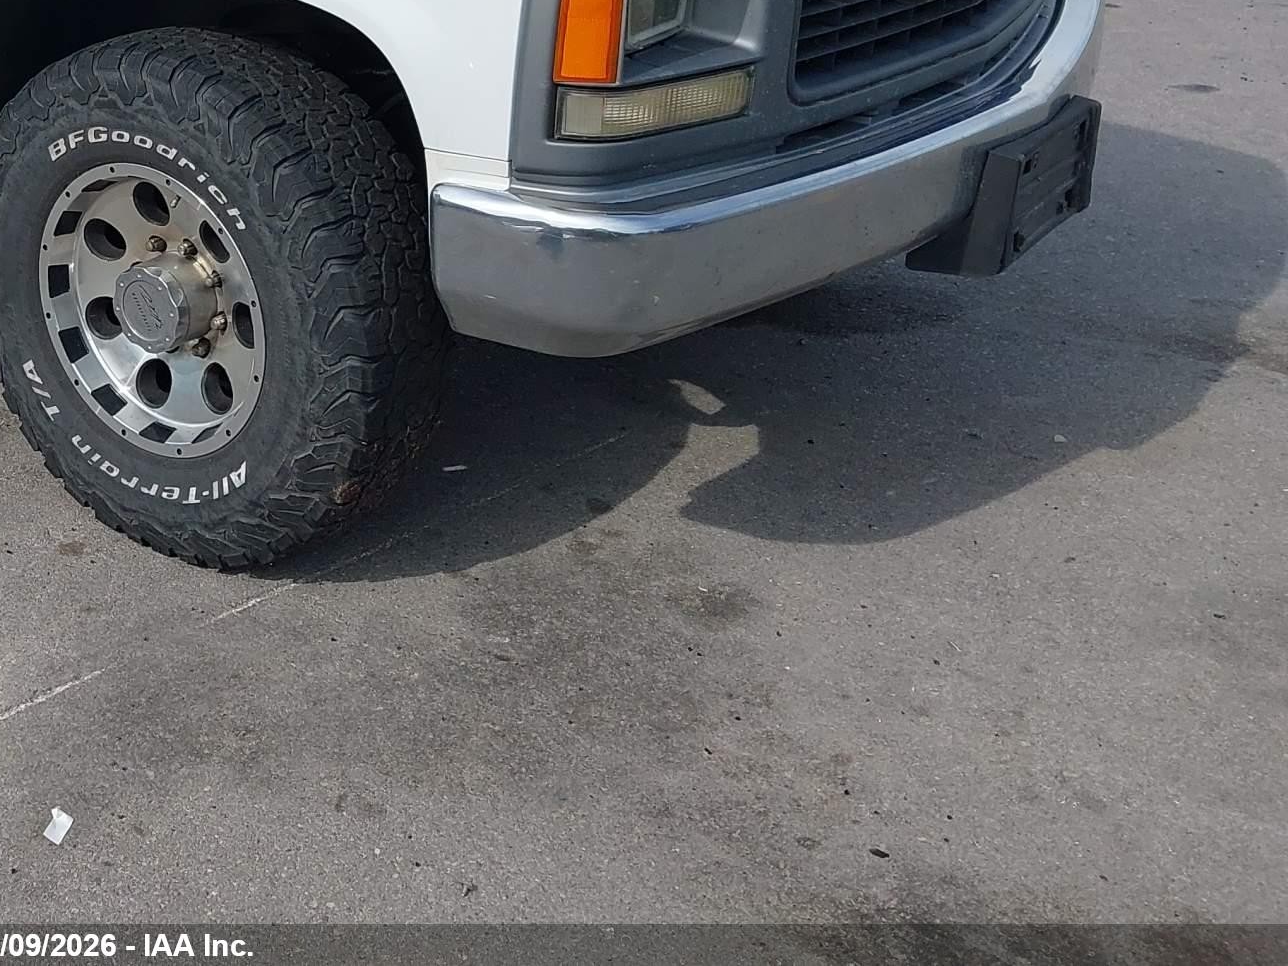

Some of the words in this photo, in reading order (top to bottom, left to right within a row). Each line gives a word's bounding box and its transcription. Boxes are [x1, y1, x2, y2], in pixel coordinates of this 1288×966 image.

[47, 126, 247, 230] BFGoodrich
[22, 359, 61, 422] T/A
[71, 434, 248, 504] All-Terrain
